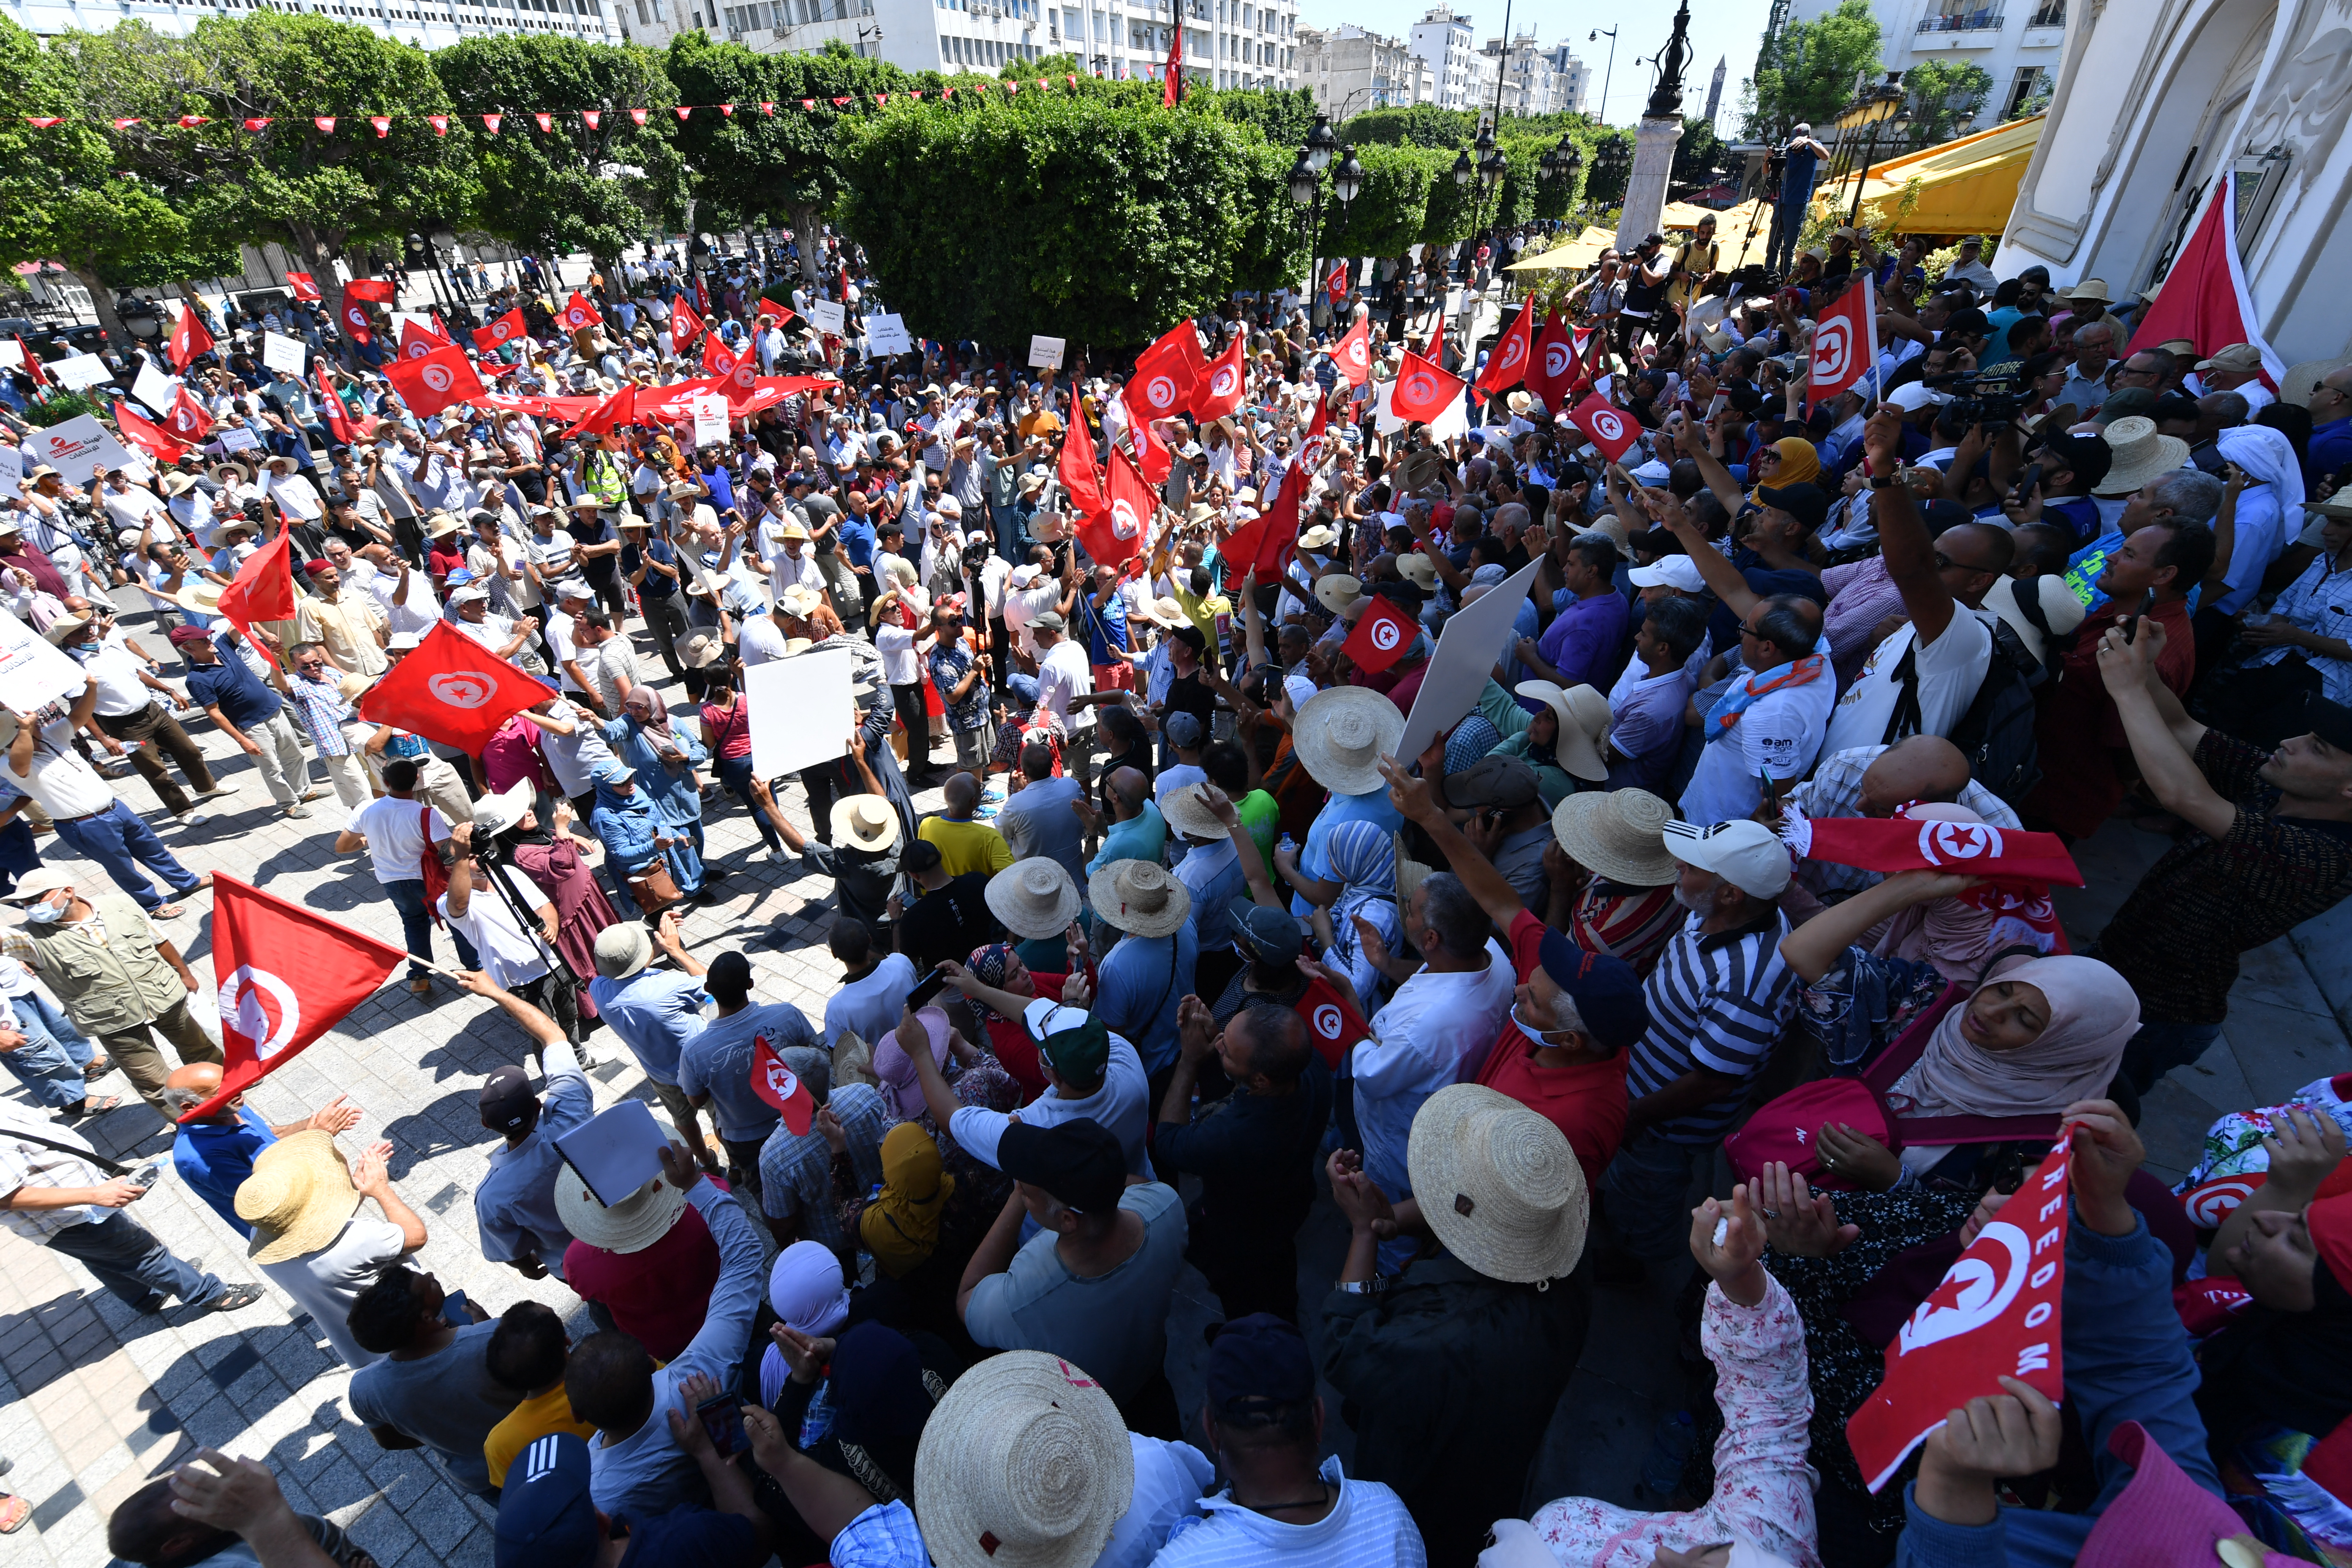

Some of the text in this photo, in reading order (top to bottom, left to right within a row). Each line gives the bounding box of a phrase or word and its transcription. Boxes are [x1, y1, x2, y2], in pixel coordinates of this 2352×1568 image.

[51, 434, 103, 457] الهيئة المستقلة
[69, 444, 100, 460] للانتخابات
[1268, 462, 1288, 473] BLACK
[10, 637, 33, 651] الهيئة
[0, 652, 35, 674] للانتخابات
[1471, 768, 1494, 779] ZEALAND
[1042, 1048, 1054, 1067] Reebok
[2016, 1135, 2070, 1376] FREEDOM
